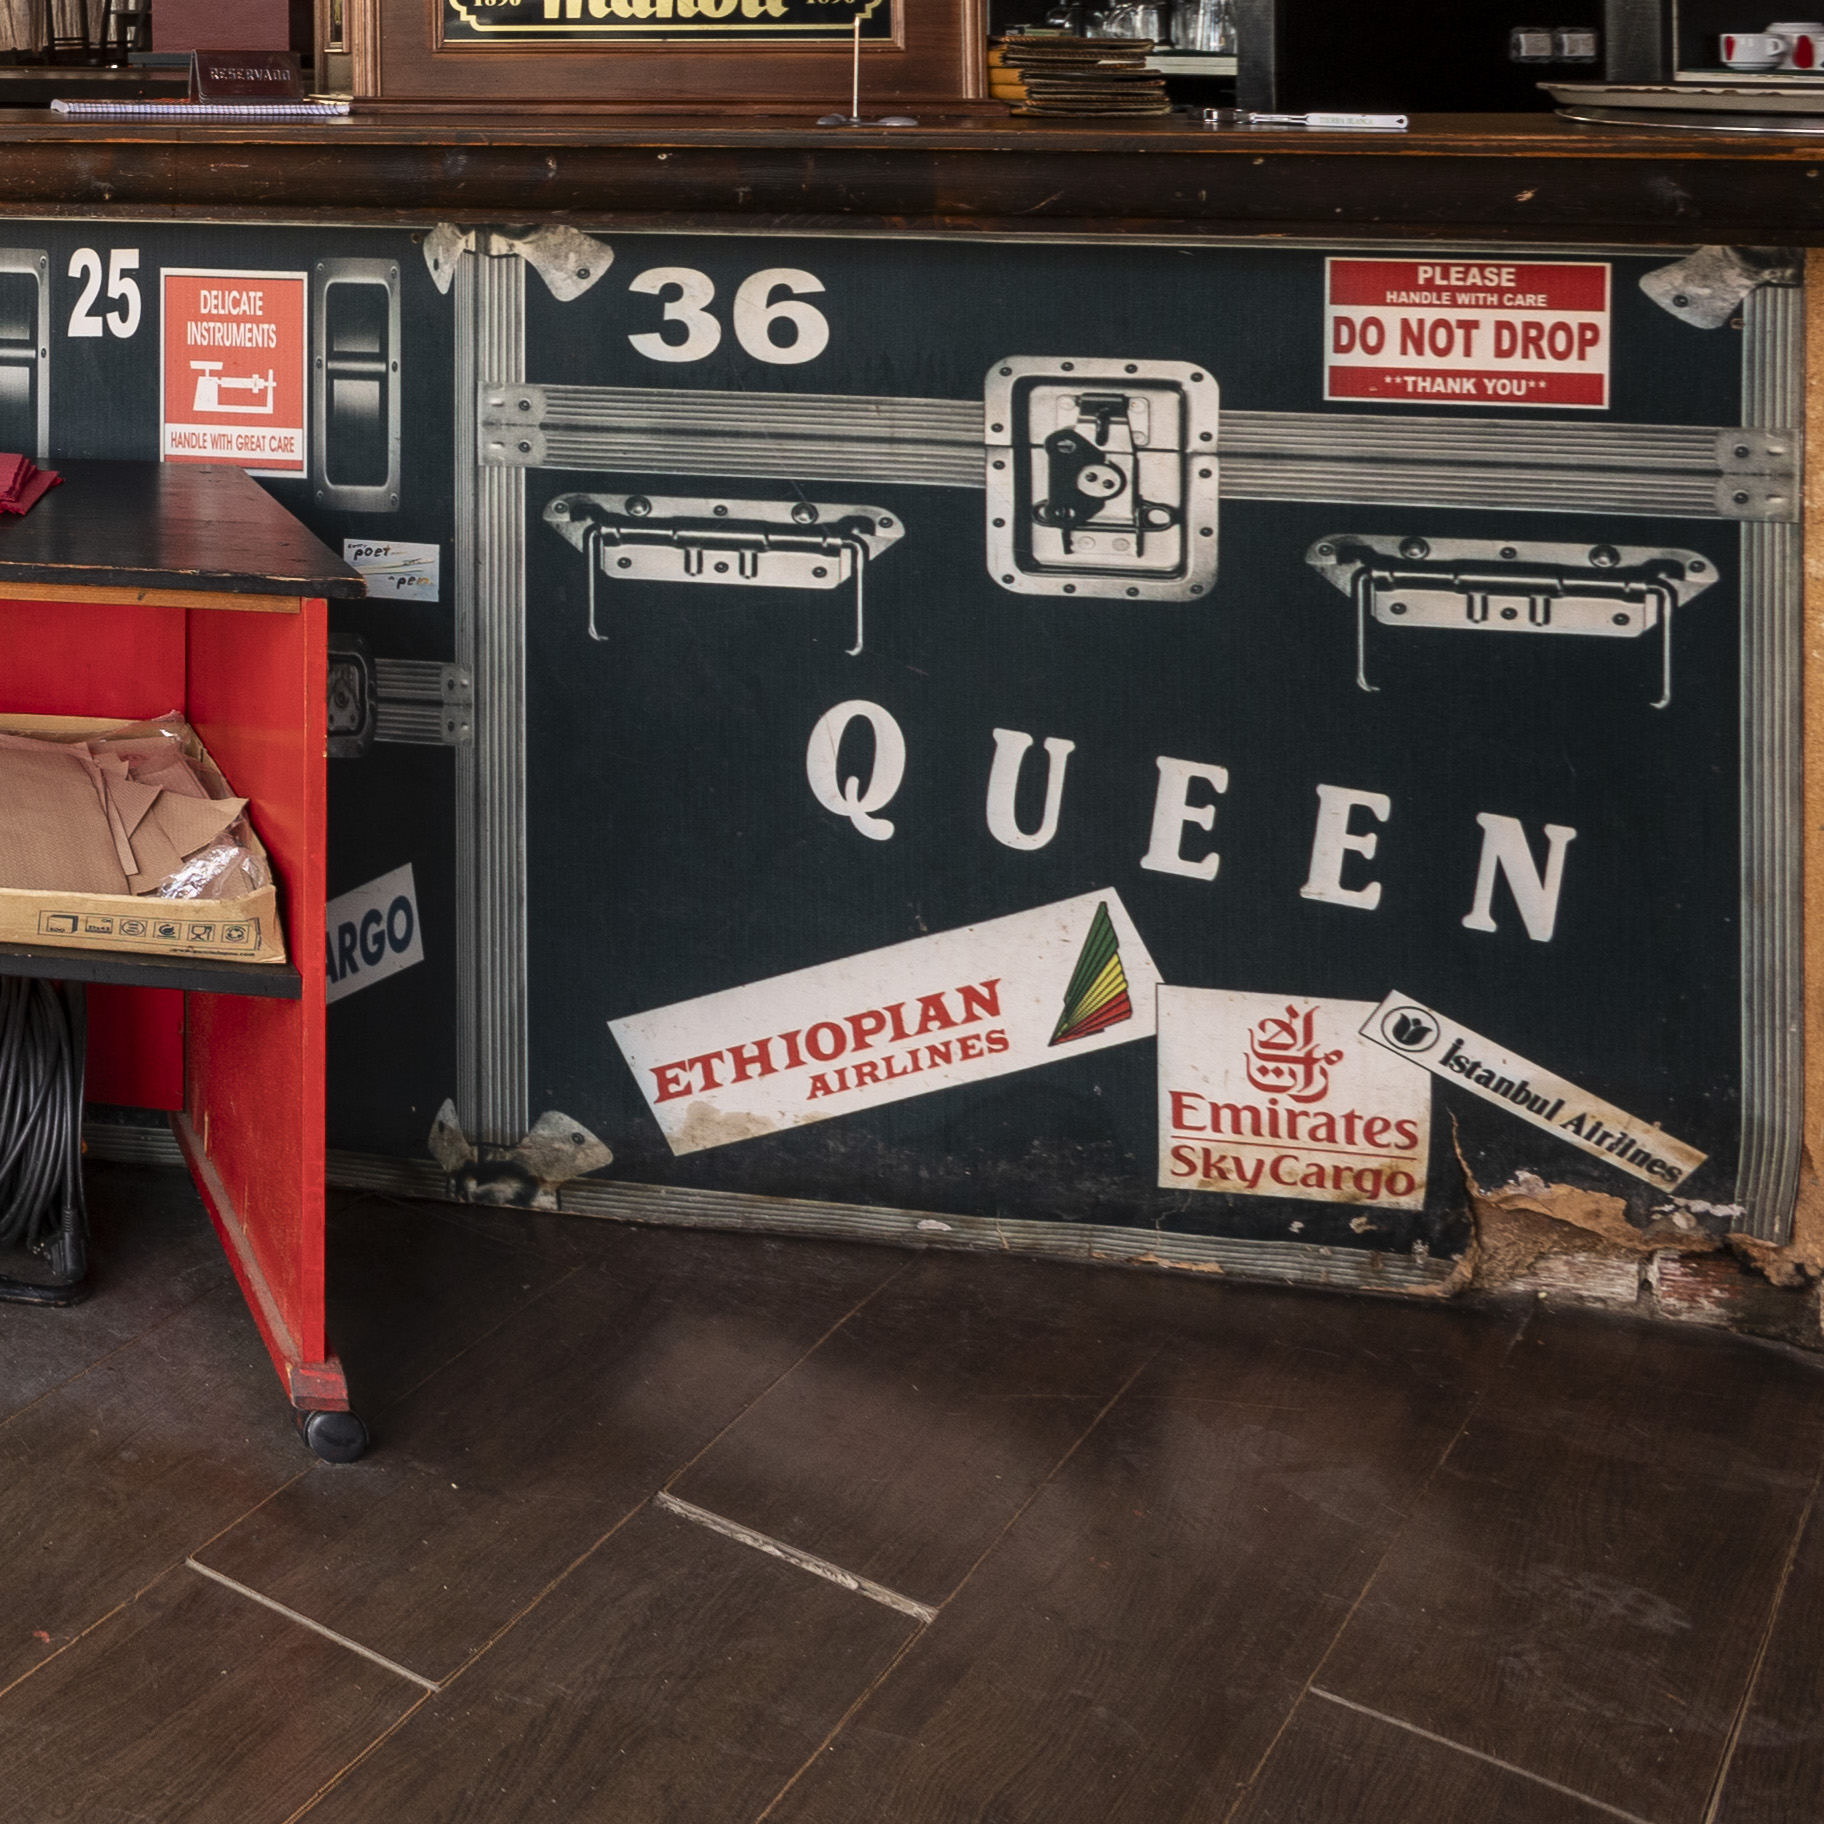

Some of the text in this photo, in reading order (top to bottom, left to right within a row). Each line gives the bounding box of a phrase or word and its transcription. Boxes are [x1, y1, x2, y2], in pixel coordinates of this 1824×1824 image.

[210, 67, 291, 81] RESERVADO
[67, 247, 142, 339] 25
[1386, 290, 1548, 307] HANDLE WITH CARE
[1417, 266, 1517, 287] PLEASE
[200, 290, 264, 316] DELICATE
[626, 265, 832, 366] 36
[187, 321, 277, 349] INSTRUMENTS
[1332, 316, 1600, 361] DO NOT DROP
[171, 431, 295, 453] HANDLE WITH GREAT CARE
[354, 545, 391, 560] poet
[804, 697, 1579, 945] QUEEN
[649, 977, 1002, 1105] ETHIOPIAN
[806, 1028, 1010, 1101] AIRLINES
[1168, 1089, 1420, 1150] Emirates
[1169, 1142, 1417, 1200] SkyCargo
